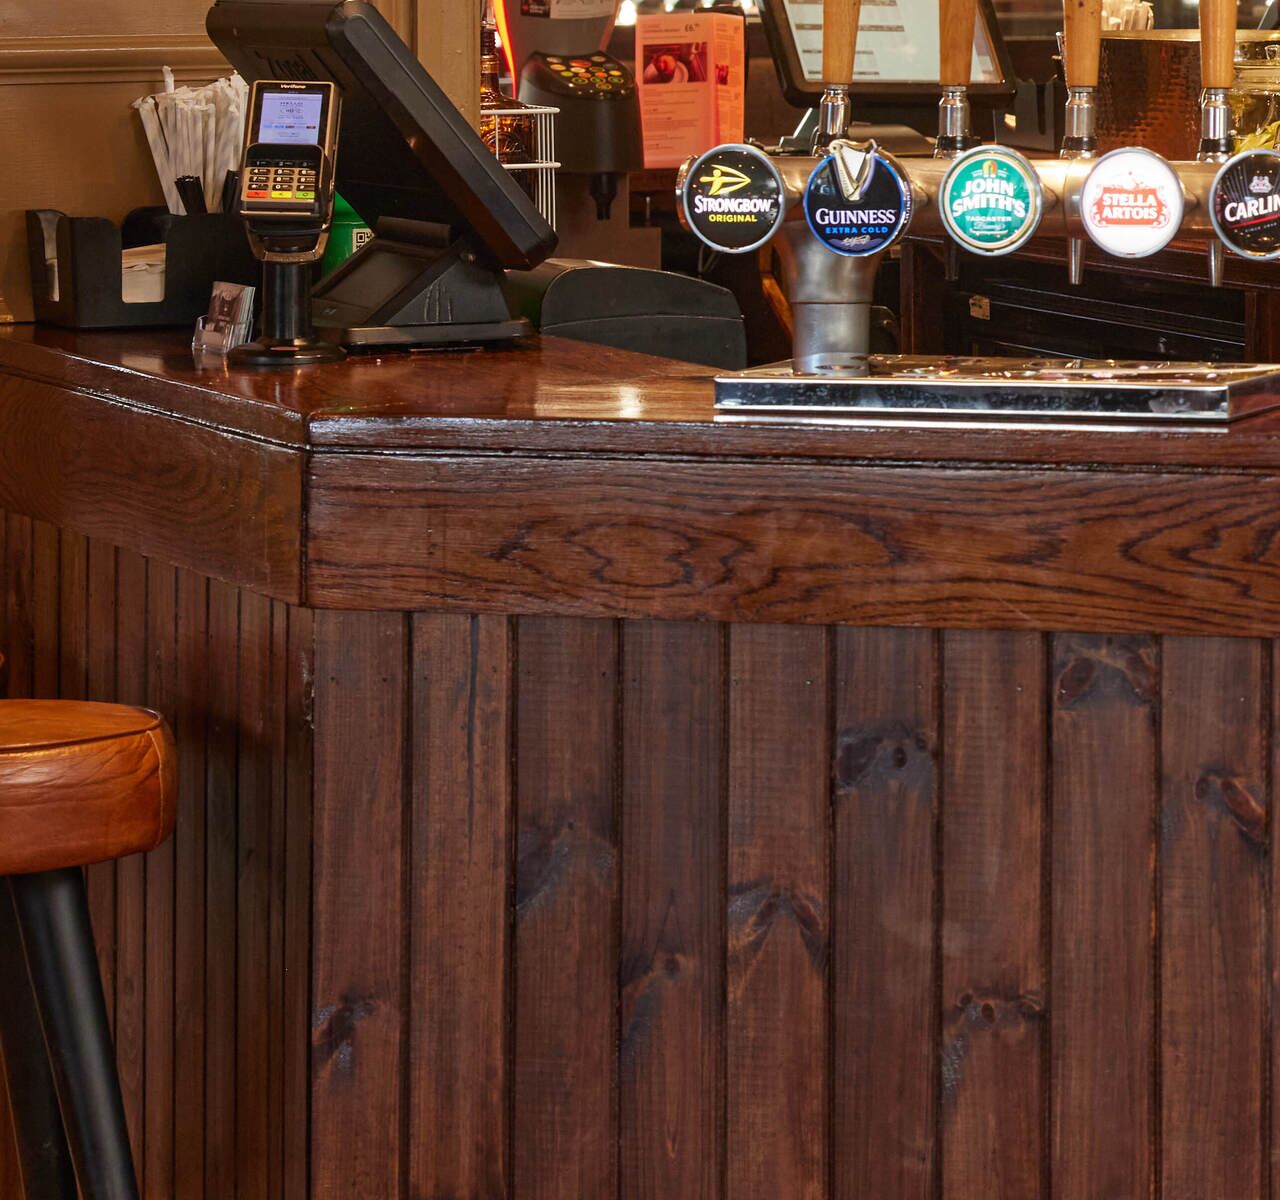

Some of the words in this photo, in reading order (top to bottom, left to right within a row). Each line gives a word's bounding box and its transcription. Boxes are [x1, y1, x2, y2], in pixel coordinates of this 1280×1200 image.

[961, 178, 1015, 198] JOHN
[694, 193, 772, 214] STRONGBOW
[952, 193, 1026, 218] SMITH'S
[1101, 193, 1158, 207] STELLA
[708, 213, 758, 223] ORIGINAL
[815, 207, 896, 225] GUINNESS
[1101, 206, 1158, 220] ARTOIS
[825, 226, 858, 235] EXTRA
[861, 226, 889, 234] COLD
